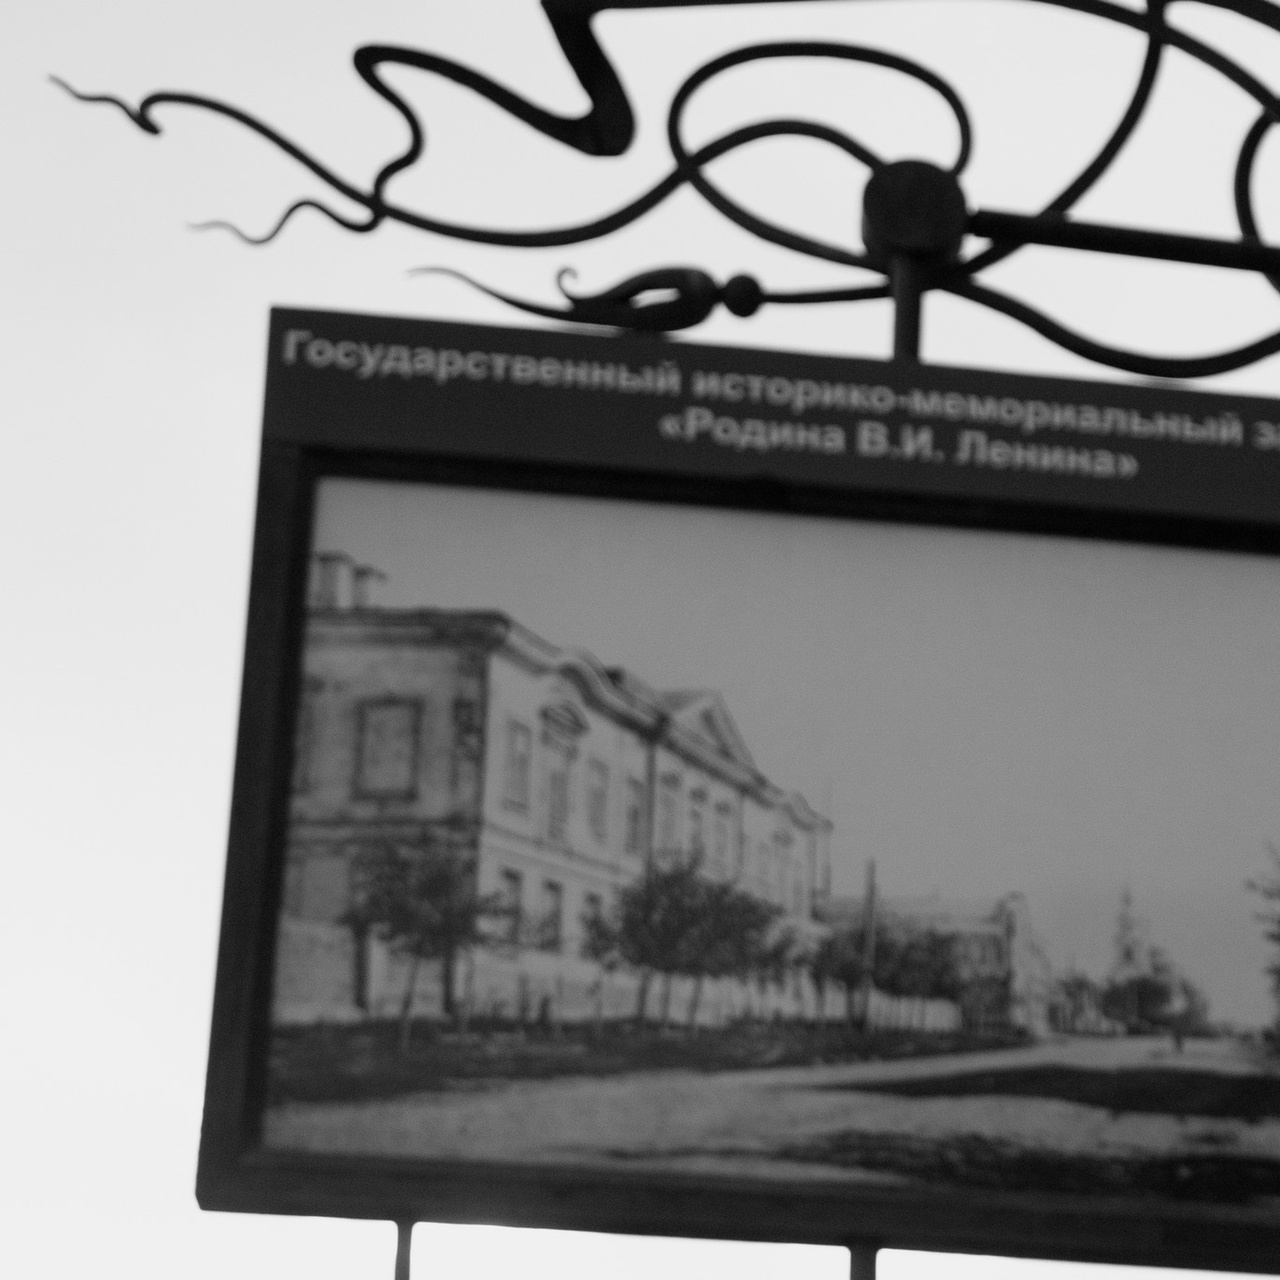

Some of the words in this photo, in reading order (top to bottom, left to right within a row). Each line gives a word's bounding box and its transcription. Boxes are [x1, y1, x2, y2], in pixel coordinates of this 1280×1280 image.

[283, 329, 682, 397] Государственный
[692, 370, 1244, 447] историко-мемориальный
[659, 407, 846, 455] «Родина
[857, 420, 945, 463] В.И.
[956, 430, 1140, 479] Ленина»
